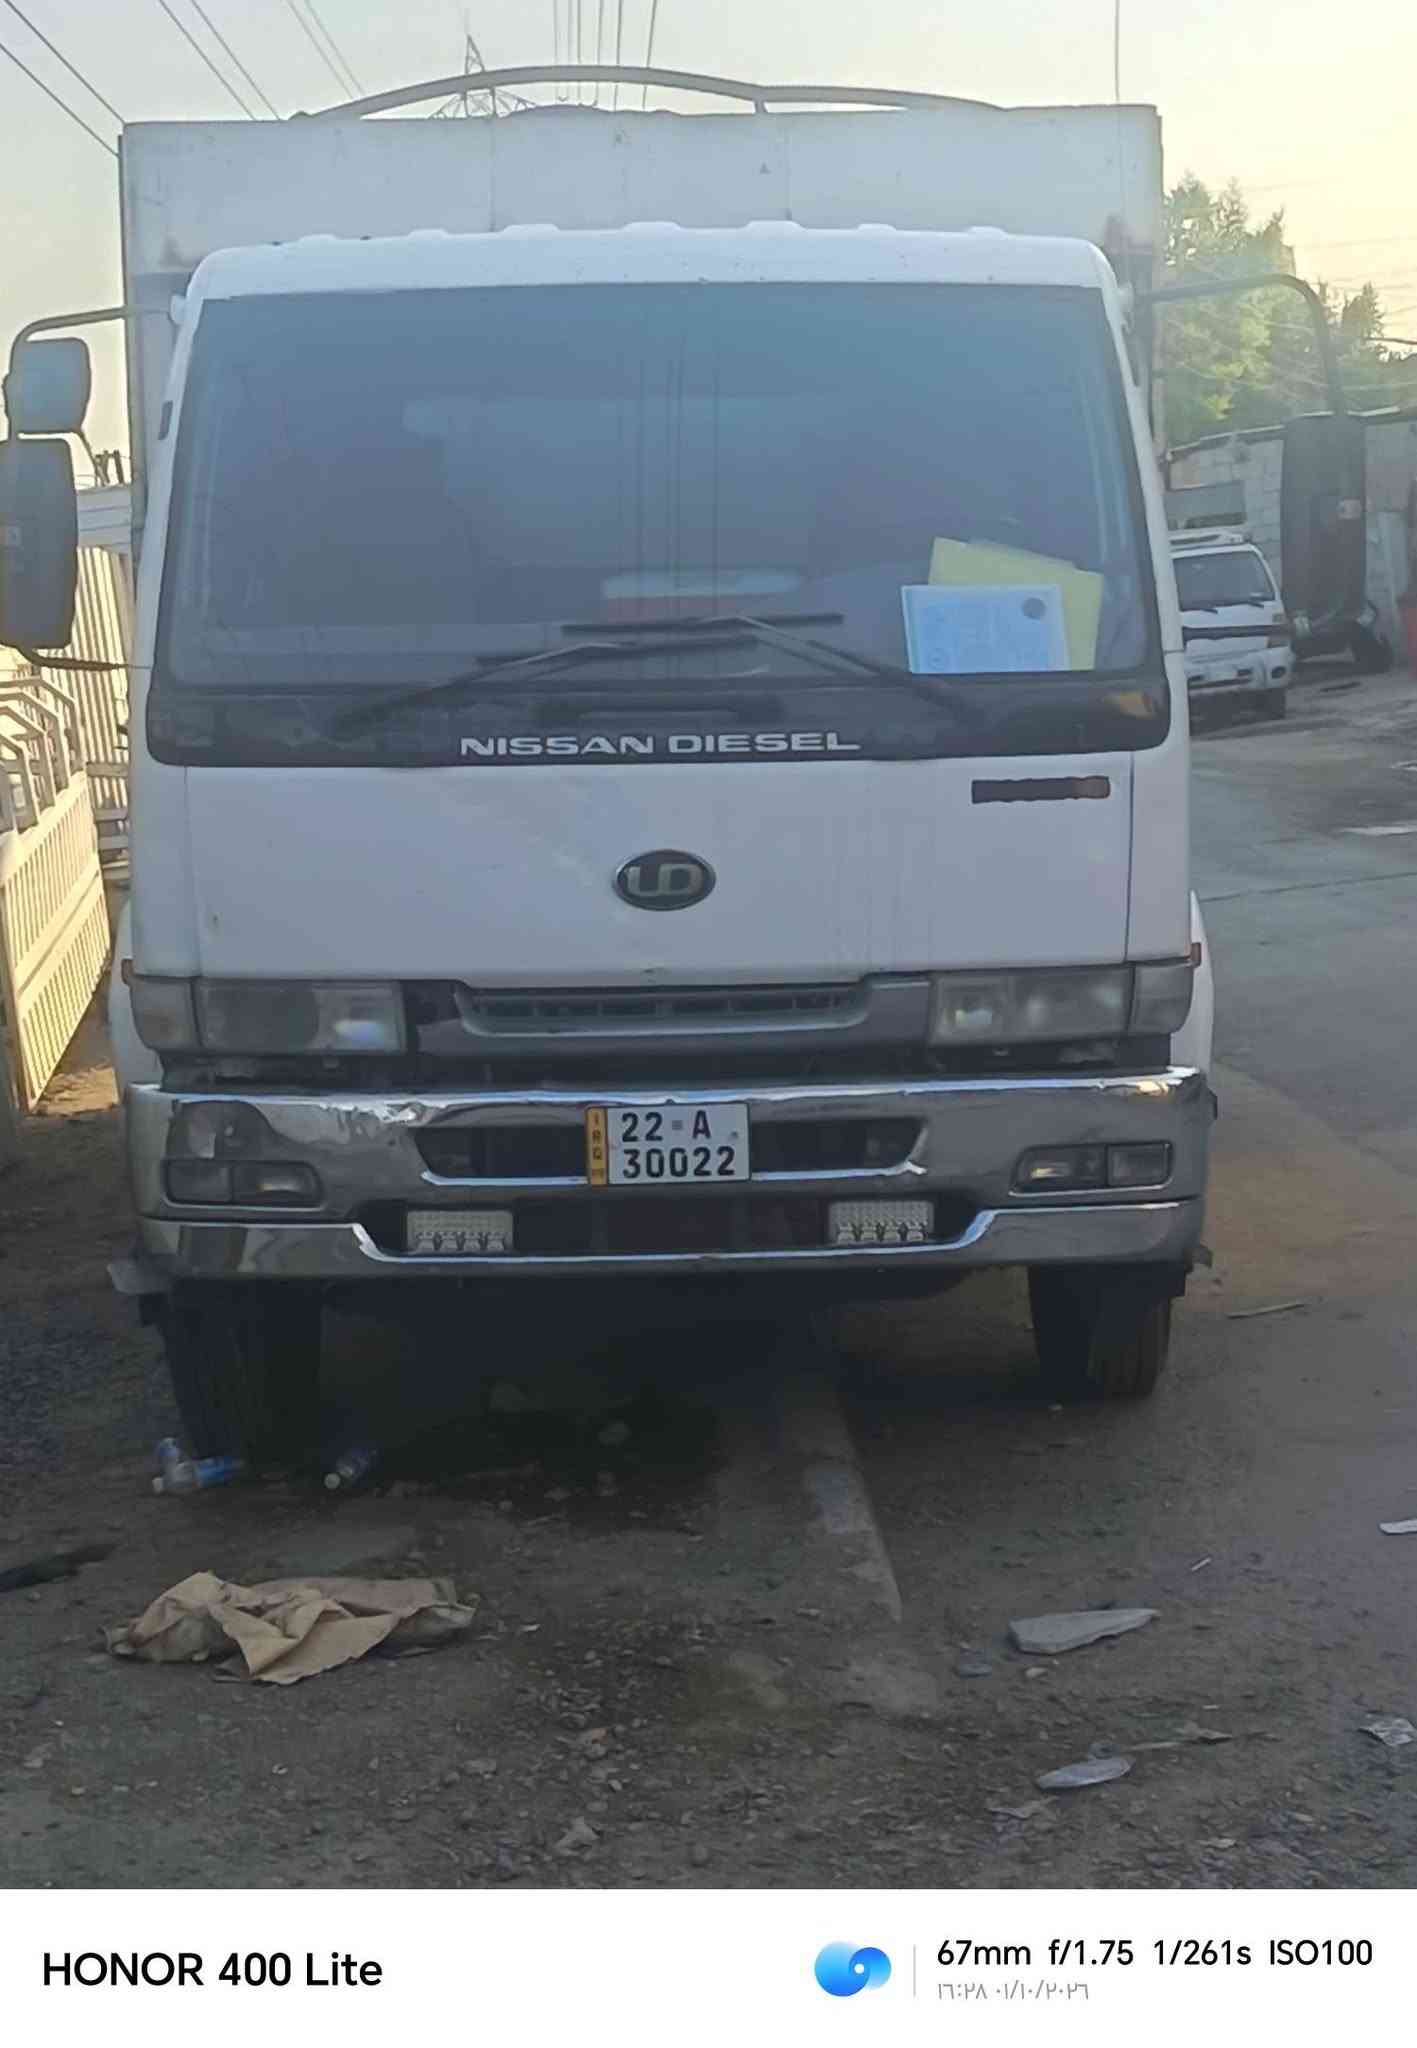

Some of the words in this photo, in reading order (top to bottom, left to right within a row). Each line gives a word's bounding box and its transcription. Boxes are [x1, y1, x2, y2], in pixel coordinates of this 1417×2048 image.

[461, 736, 653, 756] NISSAN
[668, 732, 860, 753] DIESEL
[627, 863, 702, 897] UD
[621, 1111, 664, 1143] 22
[692, 1109, 711, 1140] A
[622, 1145, 736, 1179] 30022
